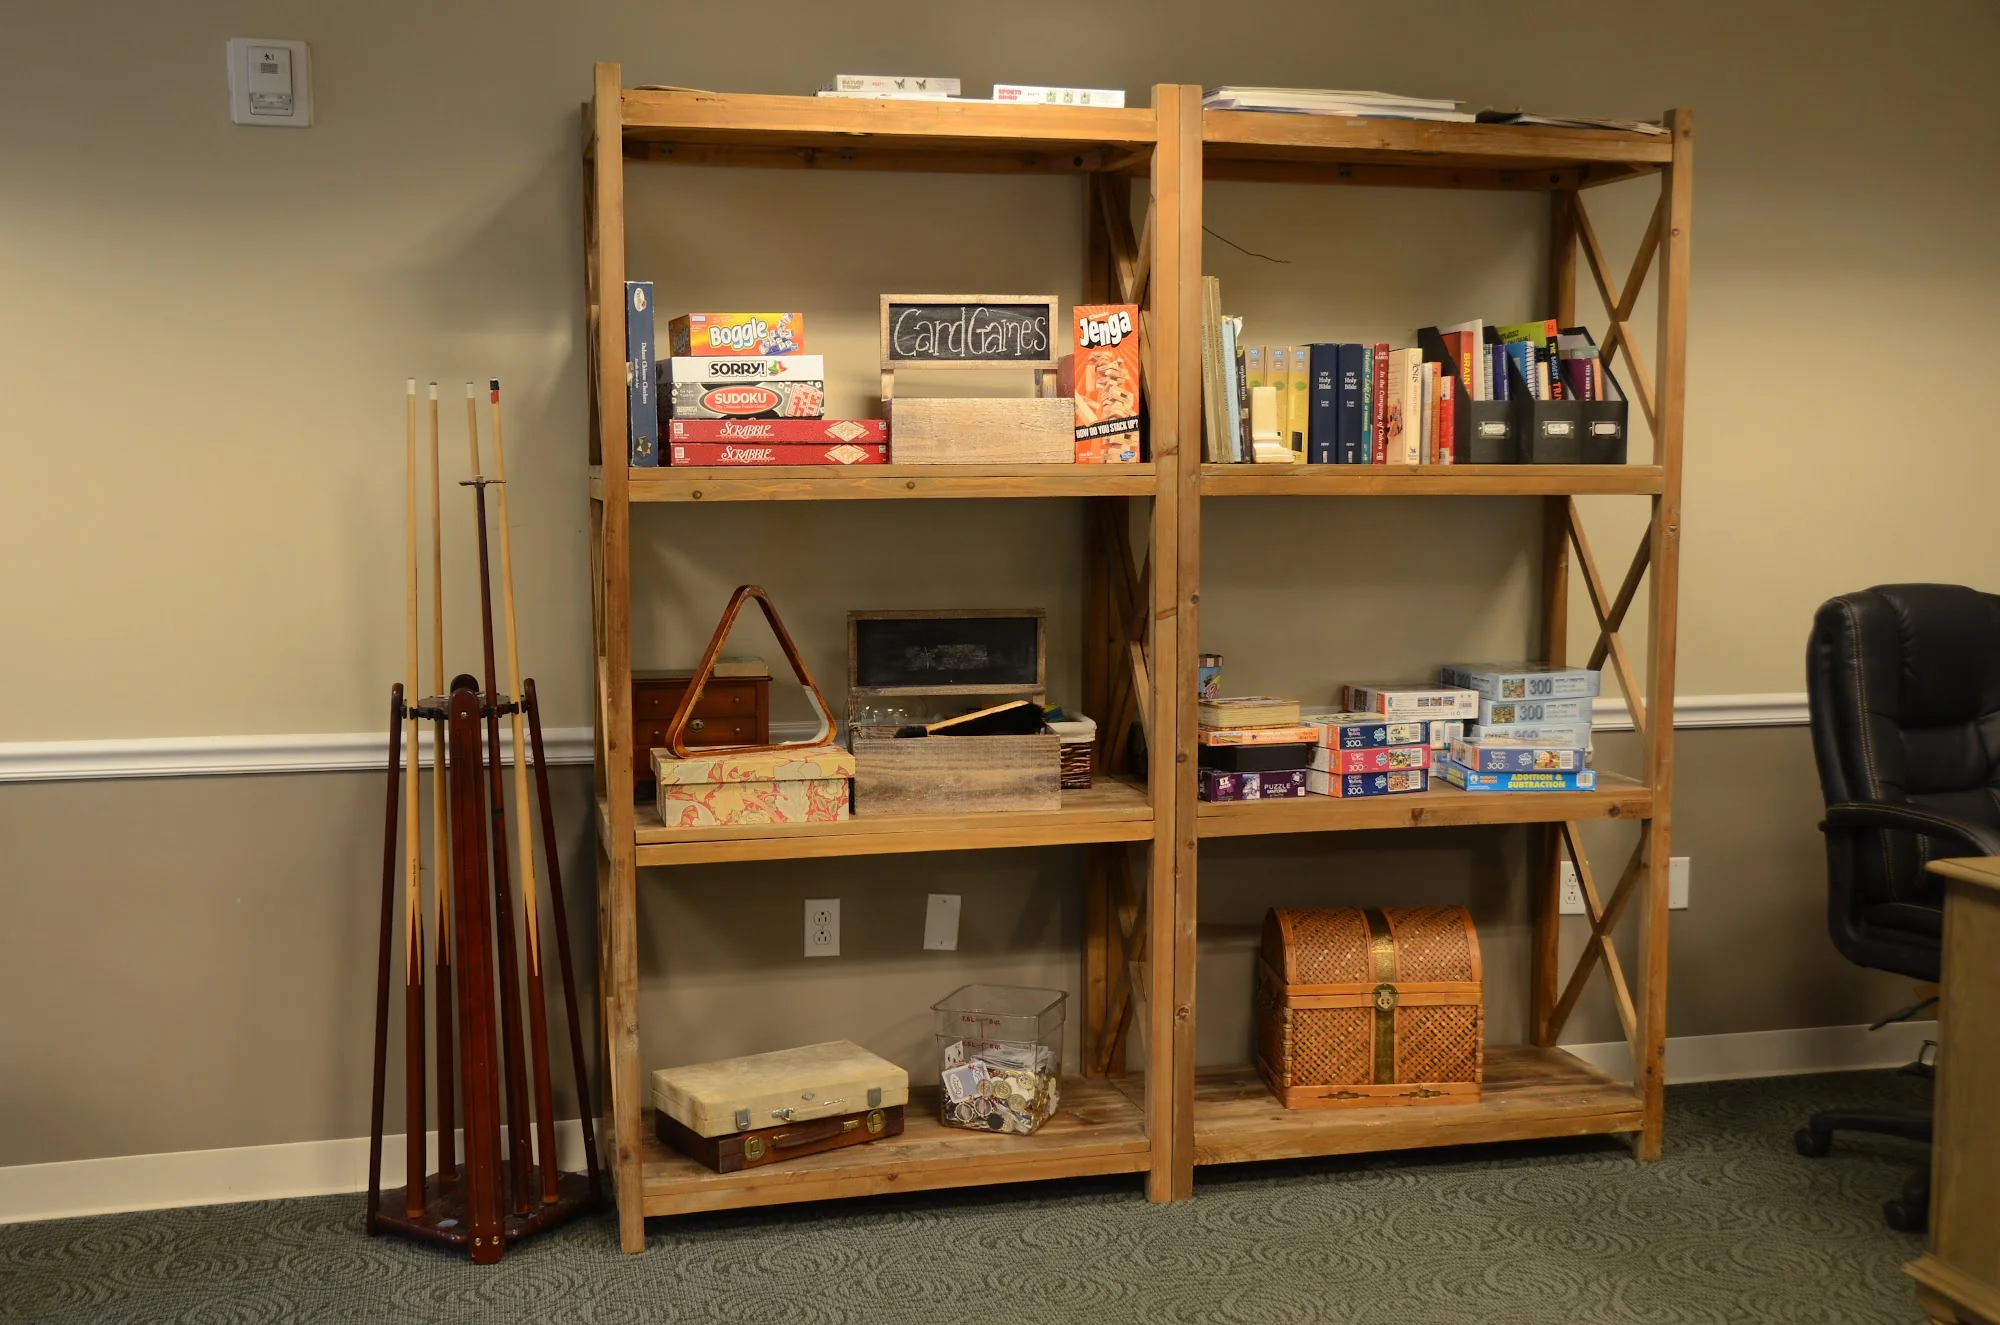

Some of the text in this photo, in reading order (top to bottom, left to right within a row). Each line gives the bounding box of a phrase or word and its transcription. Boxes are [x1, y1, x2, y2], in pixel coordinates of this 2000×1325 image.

[709, 317, 767, 349] Boggle
[1080, 311, 1132, 346] Jenga
[710, 361, 765, 376] SORRY!
[1463, 353, 1471, 384] BRAIN
[1551, 356, 1559, 379] BIGGEST
[714, 393, 767, 405] SUDOKU
[1377, 390, 1385, 420] Company
[1075, 427, 1089, 439] HOW
[1098, 425, 1109, 435] YOU
[1109, 420, 1127, 433] STACK
[1127, 419, 1138, 431] UP?
[1377, 421, 1384, 429] of
[1377, 429, 1385, 450] Others
[1529, 679, 1552, 695] 300
[1519, 704, 1543, 720] 300
[1219, 776, 1230, 786] EZ
[1348, 787, 1363, 795] 300
